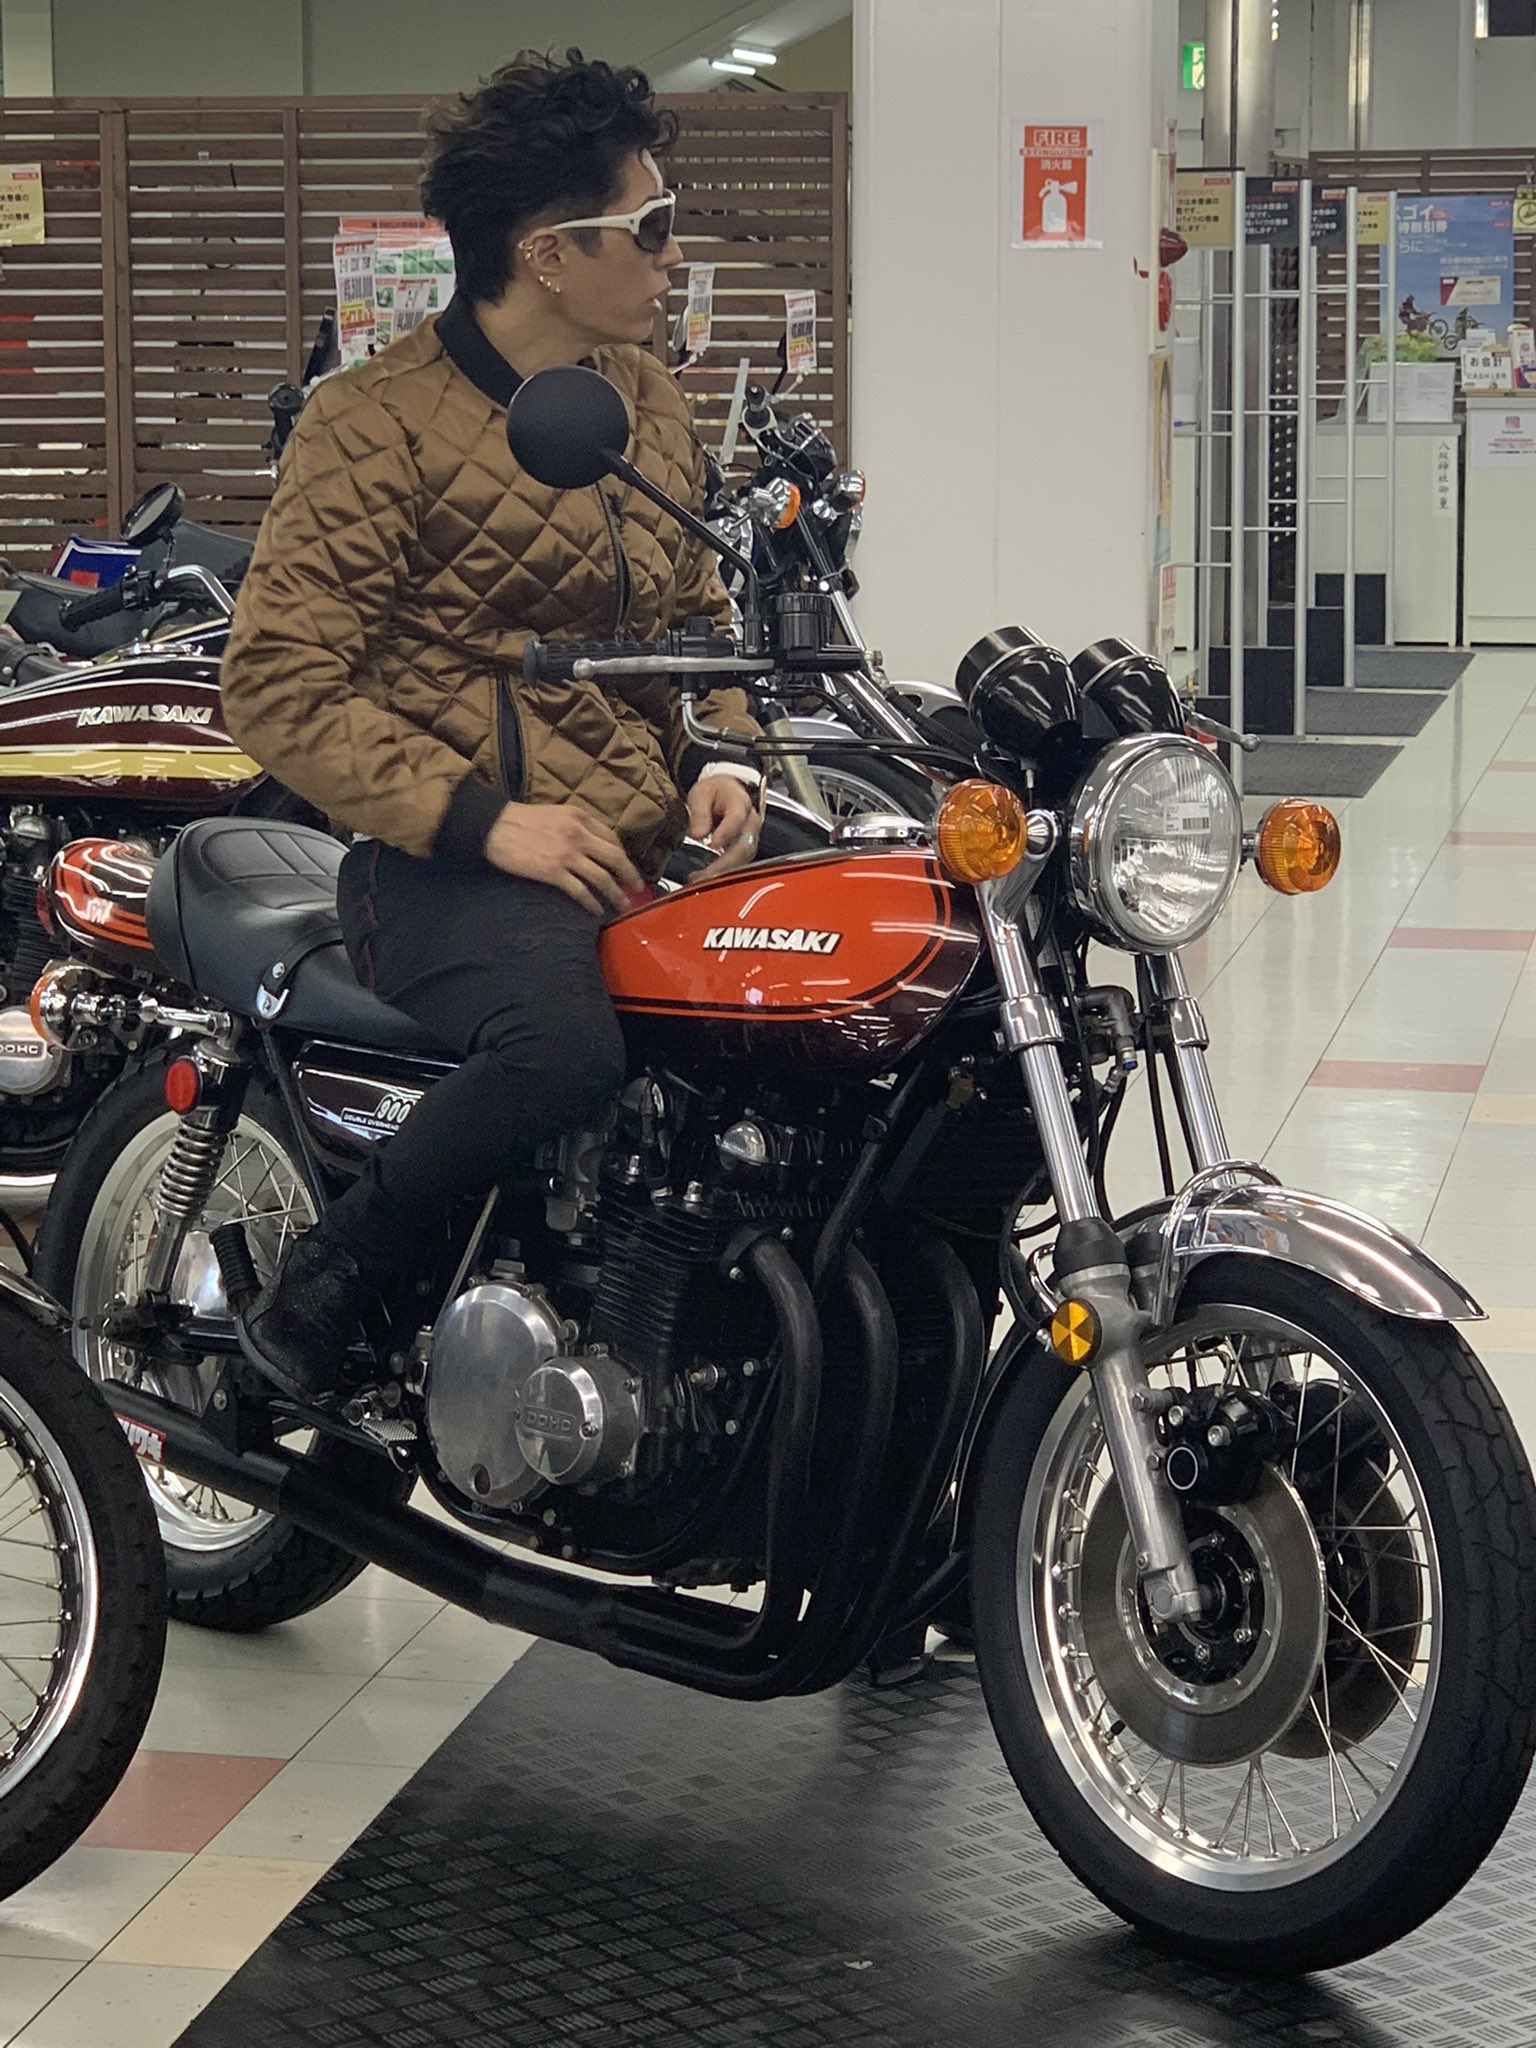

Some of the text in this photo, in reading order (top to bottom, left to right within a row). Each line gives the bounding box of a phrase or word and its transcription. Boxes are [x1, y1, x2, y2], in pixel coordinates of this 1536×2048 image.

[1035, 130, 1080, 146] FIRE
[1018, 148, 1094, 157] EXTINGUISHER
[1041, 159, 1073, 171] 消火器
[1470, 356, 1502, 368] お会計
[1467, 372, 1507, 380] CASHIER
[77, 704, 213, 727] KAWASAKI
[702, 927, 841, 954] KAWASAKI
[377, 1099, 411, 1123] 900
[344, 1113, 400, 1131] DOUBLE OVERHEAD
[526, 1411, 572, 1431] DOHC
